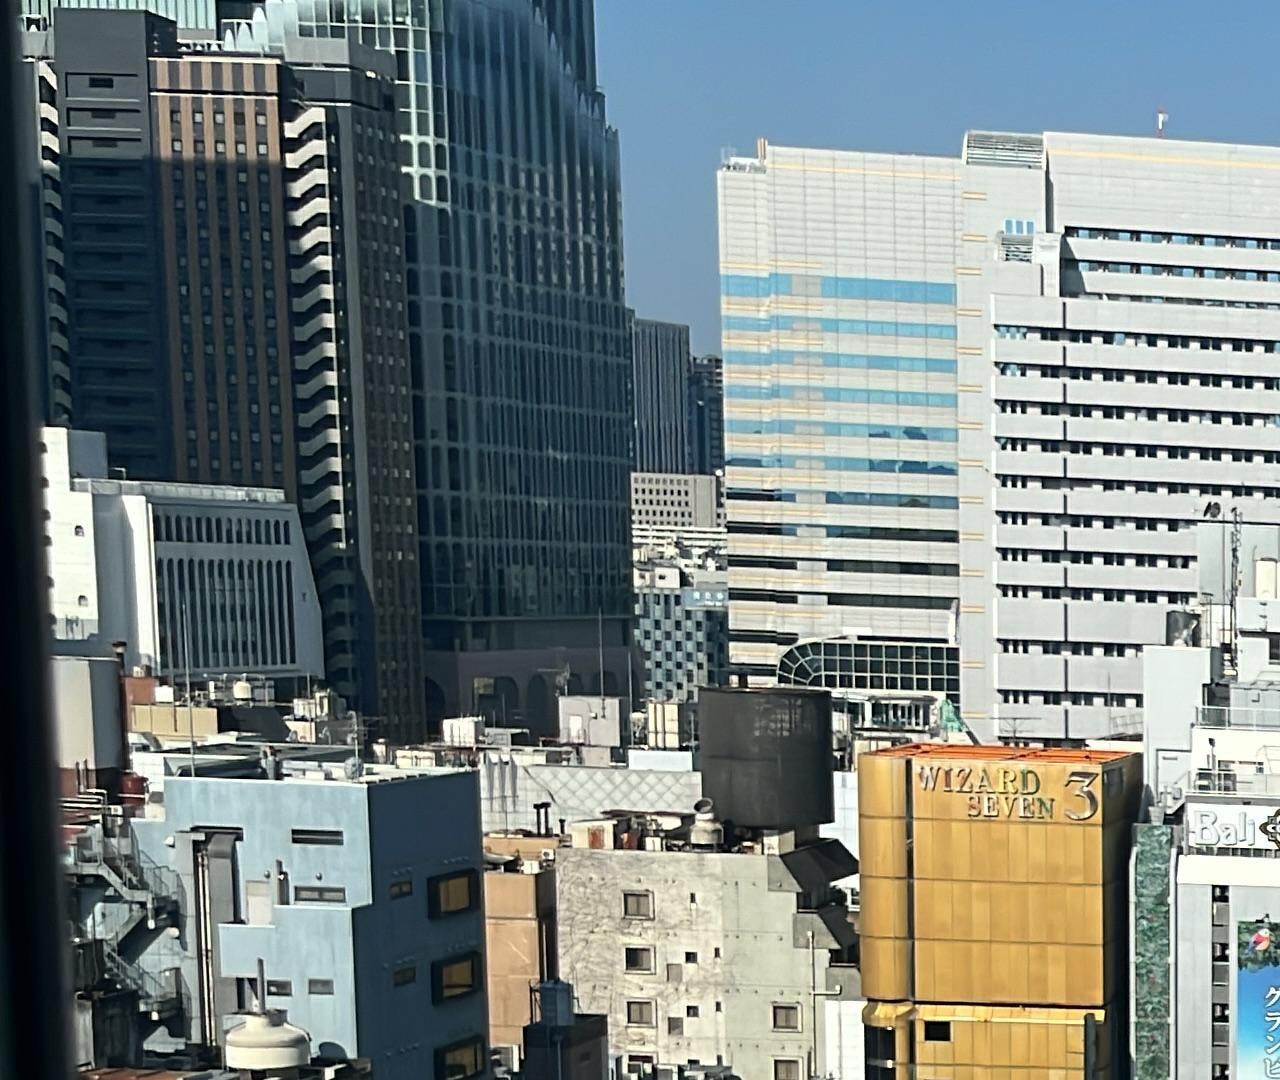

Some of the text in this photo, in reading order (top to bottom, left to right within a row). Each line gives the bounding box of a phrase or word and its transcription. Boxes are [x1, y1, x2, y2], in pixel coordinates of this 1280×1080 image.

[918, 765, 1041, 796] WIZARD
[968, 770, 1100, 821] SEVEN 3
[1191, 810, 1255, 847] Bali
